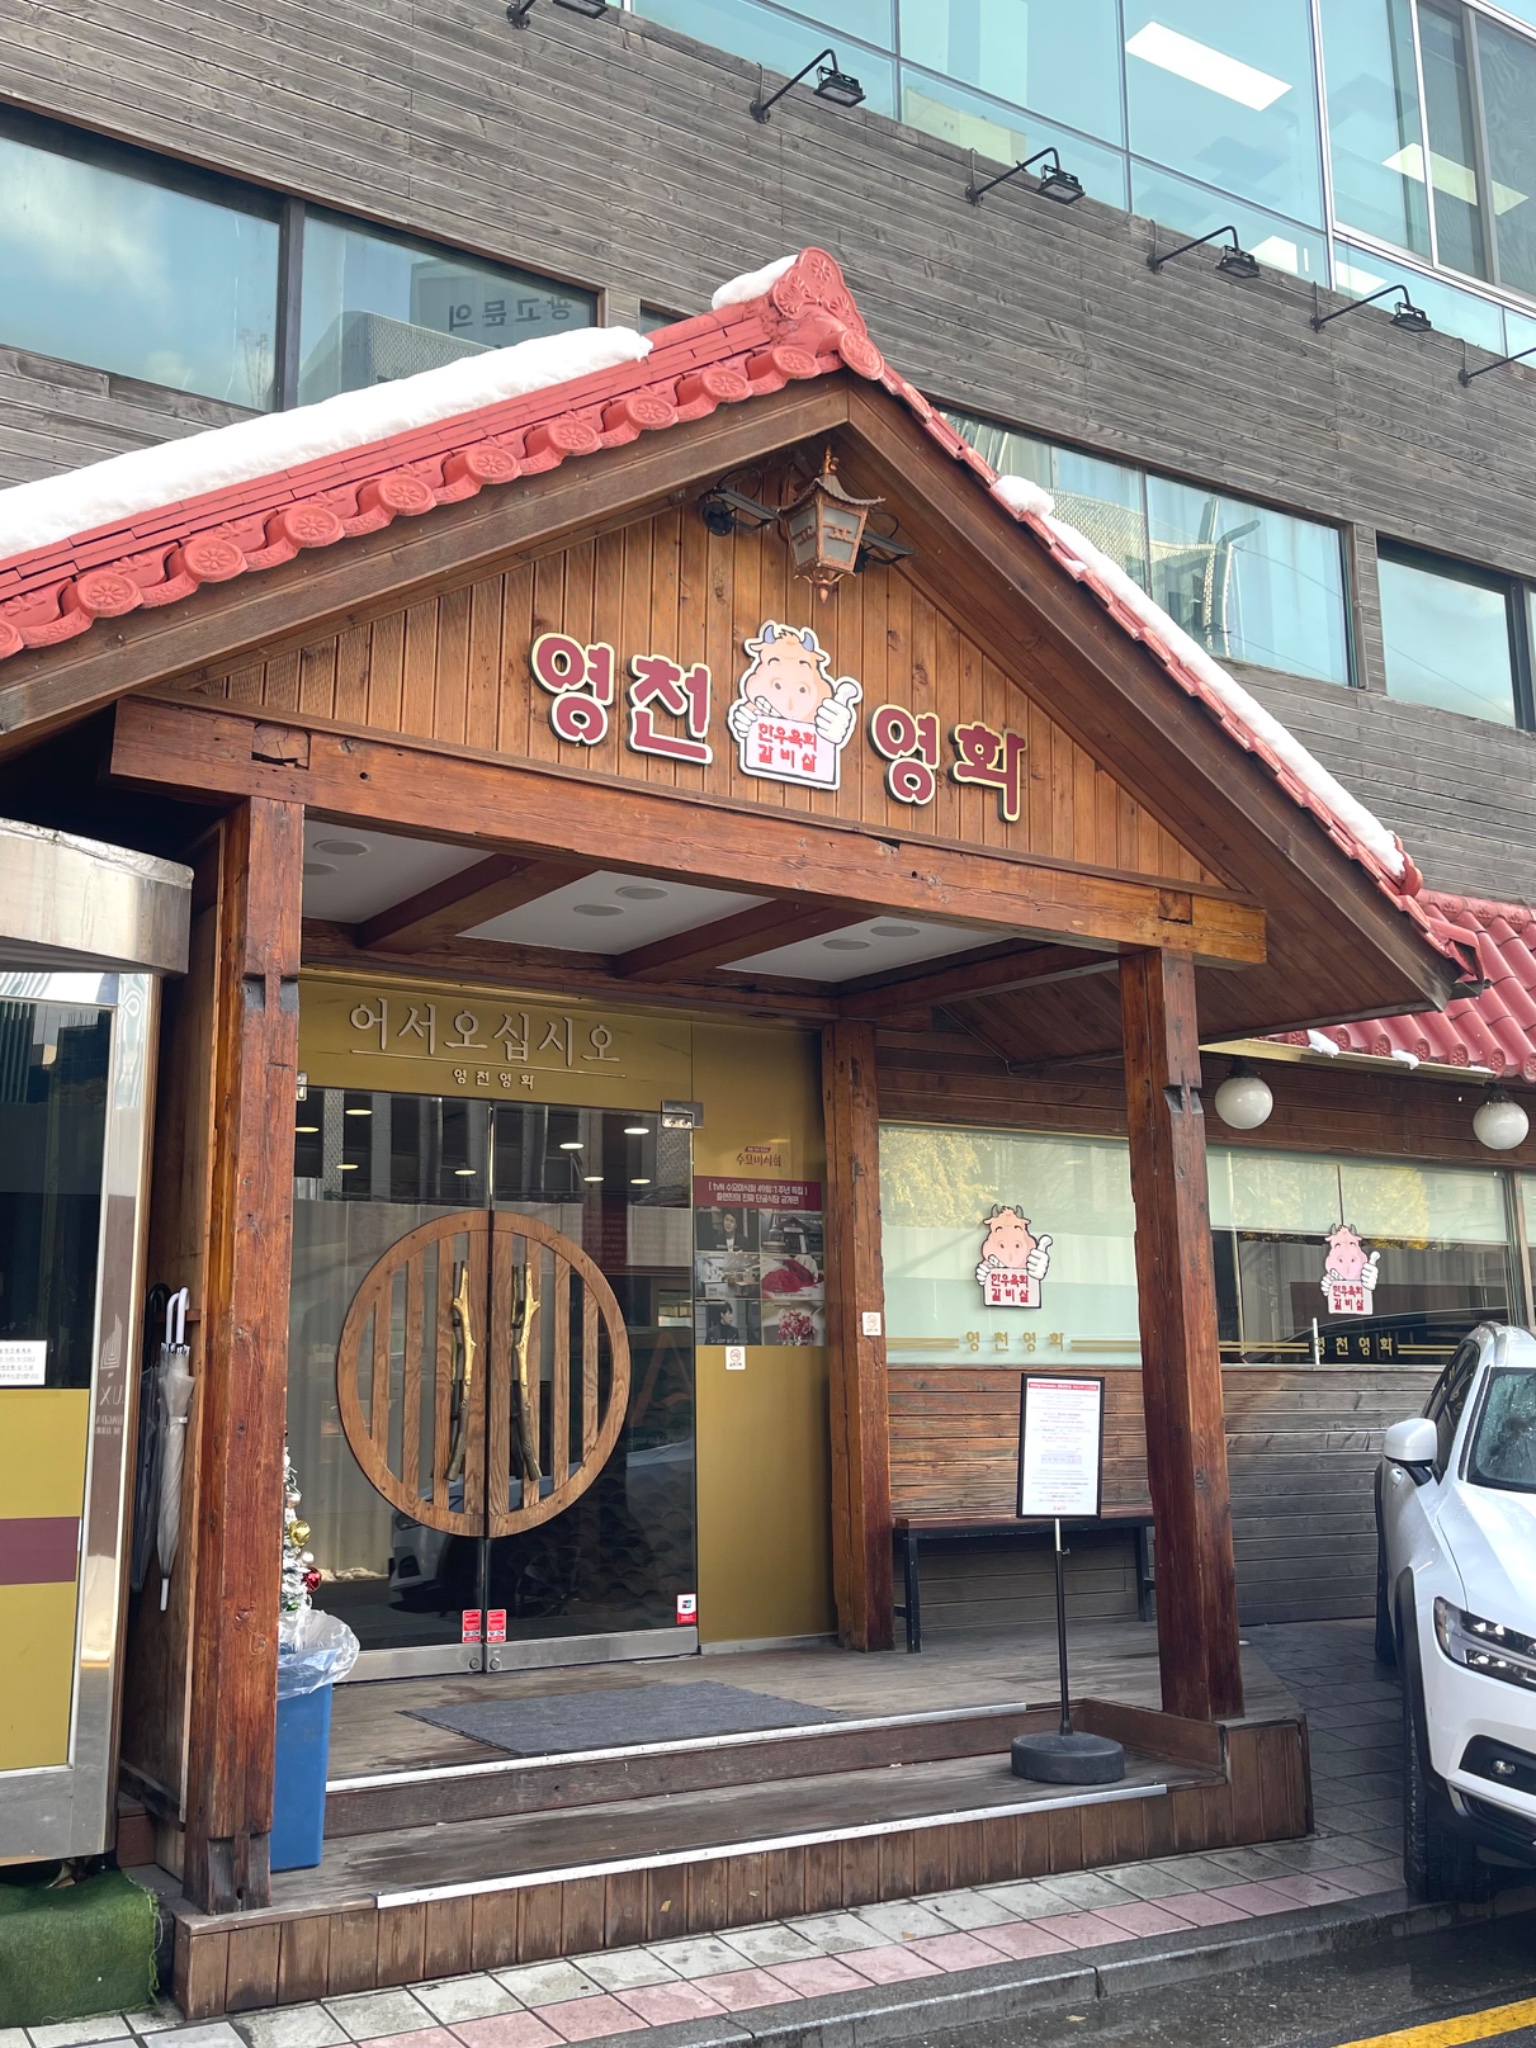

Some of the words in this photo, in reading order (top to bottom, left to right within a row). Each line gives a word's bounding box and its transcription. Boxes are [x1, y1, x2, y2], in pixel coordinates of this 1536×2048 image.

[532, 633, 712, 764] 영천
[870, 704, 1026, 822] 영화
[758, 722, 818, 751] 한우육회
[758, 744, 817, 773] 갈비살
[350, 997, 621, 1067] 어서오십시오
[452, 1068, 535, 1090] 영천영화
[990, 1273, 1029, 1288] 한우육회
[991, 1288, 1030, 1303] 갈비살
[965, 1330, 1065, 1353] 영천영화
